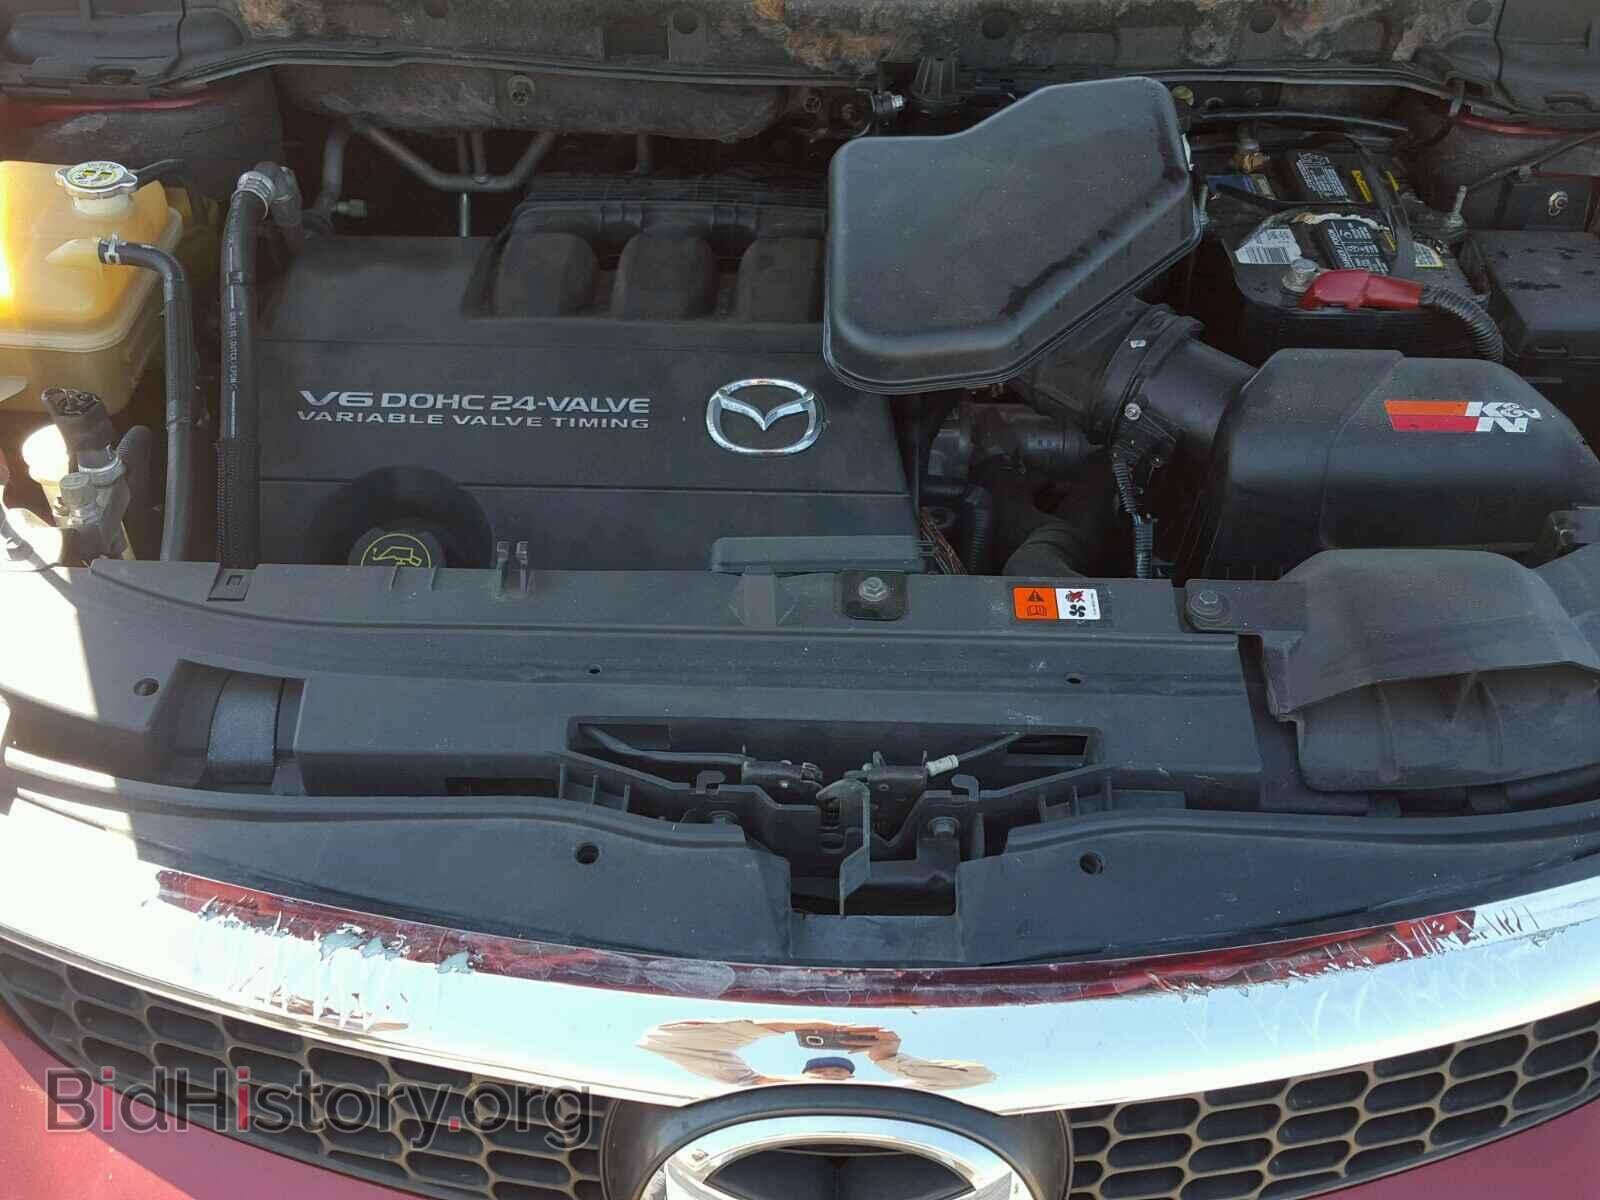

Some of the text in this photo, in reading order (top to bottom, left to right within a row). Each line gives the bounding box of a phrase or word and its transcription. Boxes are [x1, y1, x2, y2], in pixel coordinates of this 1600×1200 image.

[300, 390, 650, 414] V6 DOHC 24-VALVE
[297, 410, 649, 429] VARIABLE VALVE TIMING
